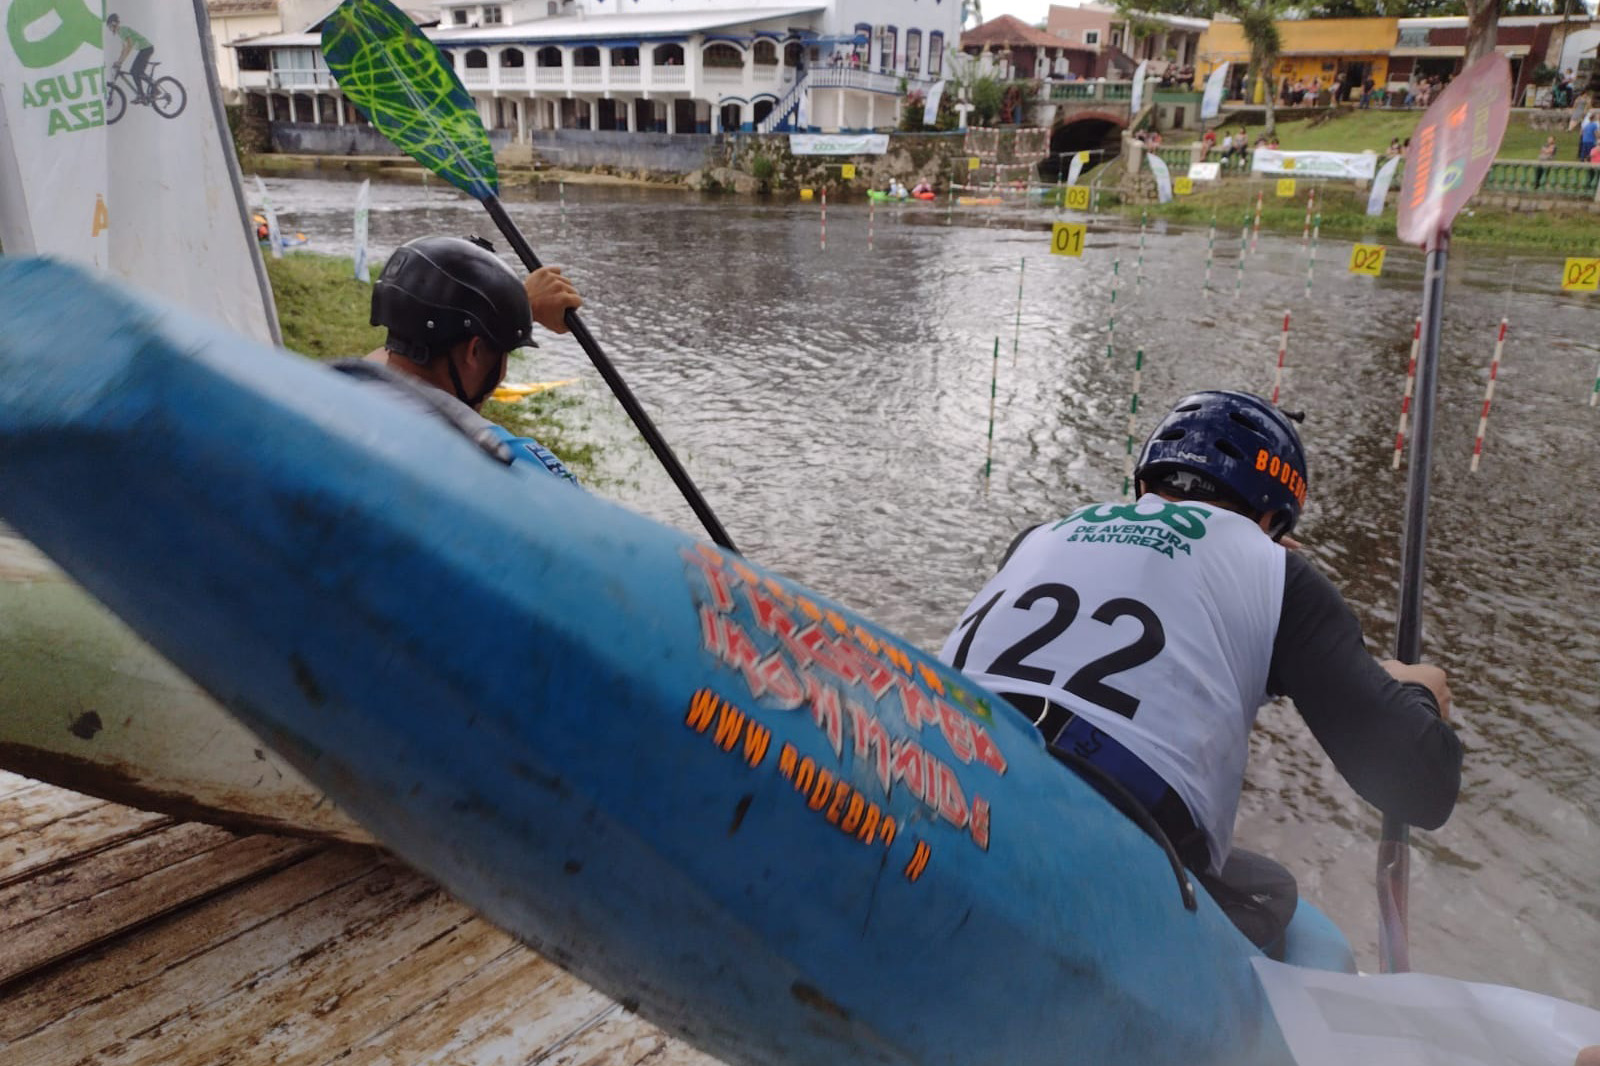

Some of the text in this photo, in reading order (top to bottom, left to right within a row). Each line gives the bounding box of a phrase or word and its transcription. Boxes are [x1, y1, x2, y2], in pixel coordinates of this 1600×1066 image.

[1068, 189, 1085, 205] 03
[1056, 227, 1081, 252] 01
[1353, 248, 1380, 270] 02
[1567, 263, 1597, 285] 02
[1067, 533, 1174, 559] & NATUREZA
[1073, 525, 1192, 556] DE AVENTURA
[952, 582, 1166, 721] 122
